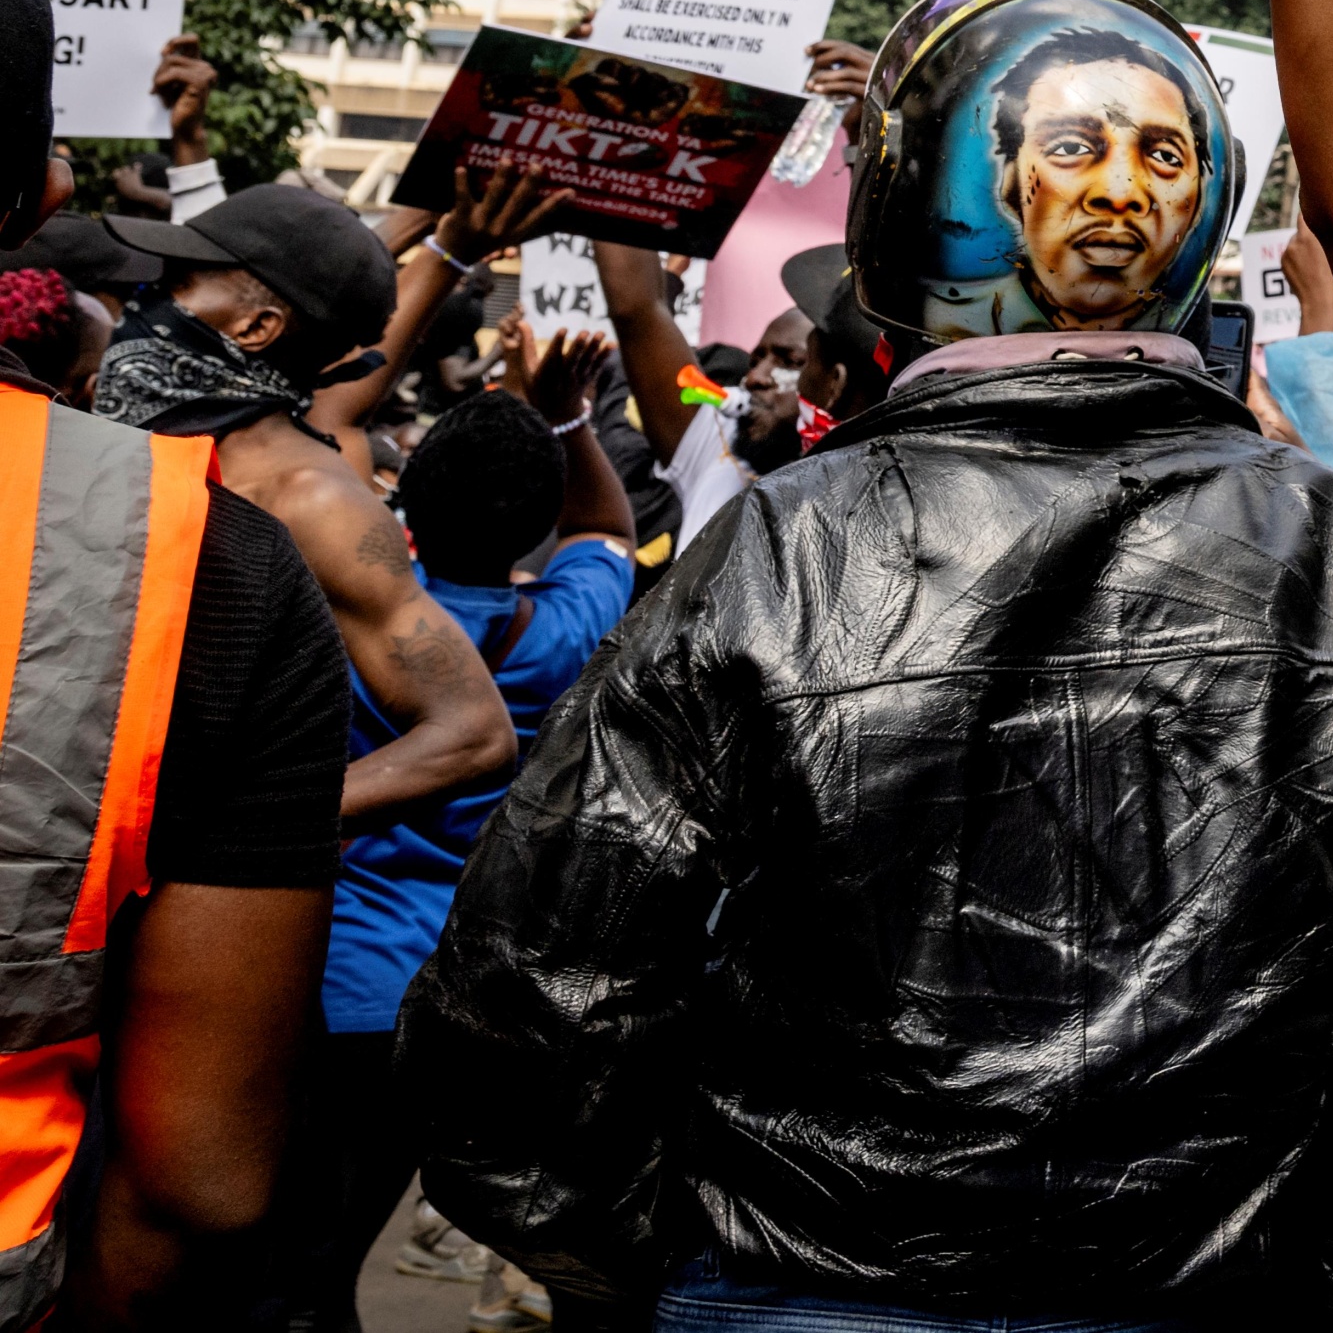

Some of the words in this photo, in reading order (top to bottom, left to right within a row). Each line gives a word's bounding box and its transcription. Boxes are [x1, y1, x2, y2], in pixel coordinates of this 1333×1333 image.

[672, 0, 742, 23] EXERCISED
[743, 8, 775, 26] ONLY
[777, 12, 792, 28] IN
[623, 24, 706, 47] ACCORDANCE
[706, 32, 735, 52] WITH
[737, 36, 764, 55] THIS
[526, 102, 669, 143] GENERATION
[676, 134, 702, 149] YA
[549, 170, 604, 190] WALK
[610, 182, 643, 198] THE
[588, 164, 660, 189] TIME'S
[665, 180, 706, 200] UP!
